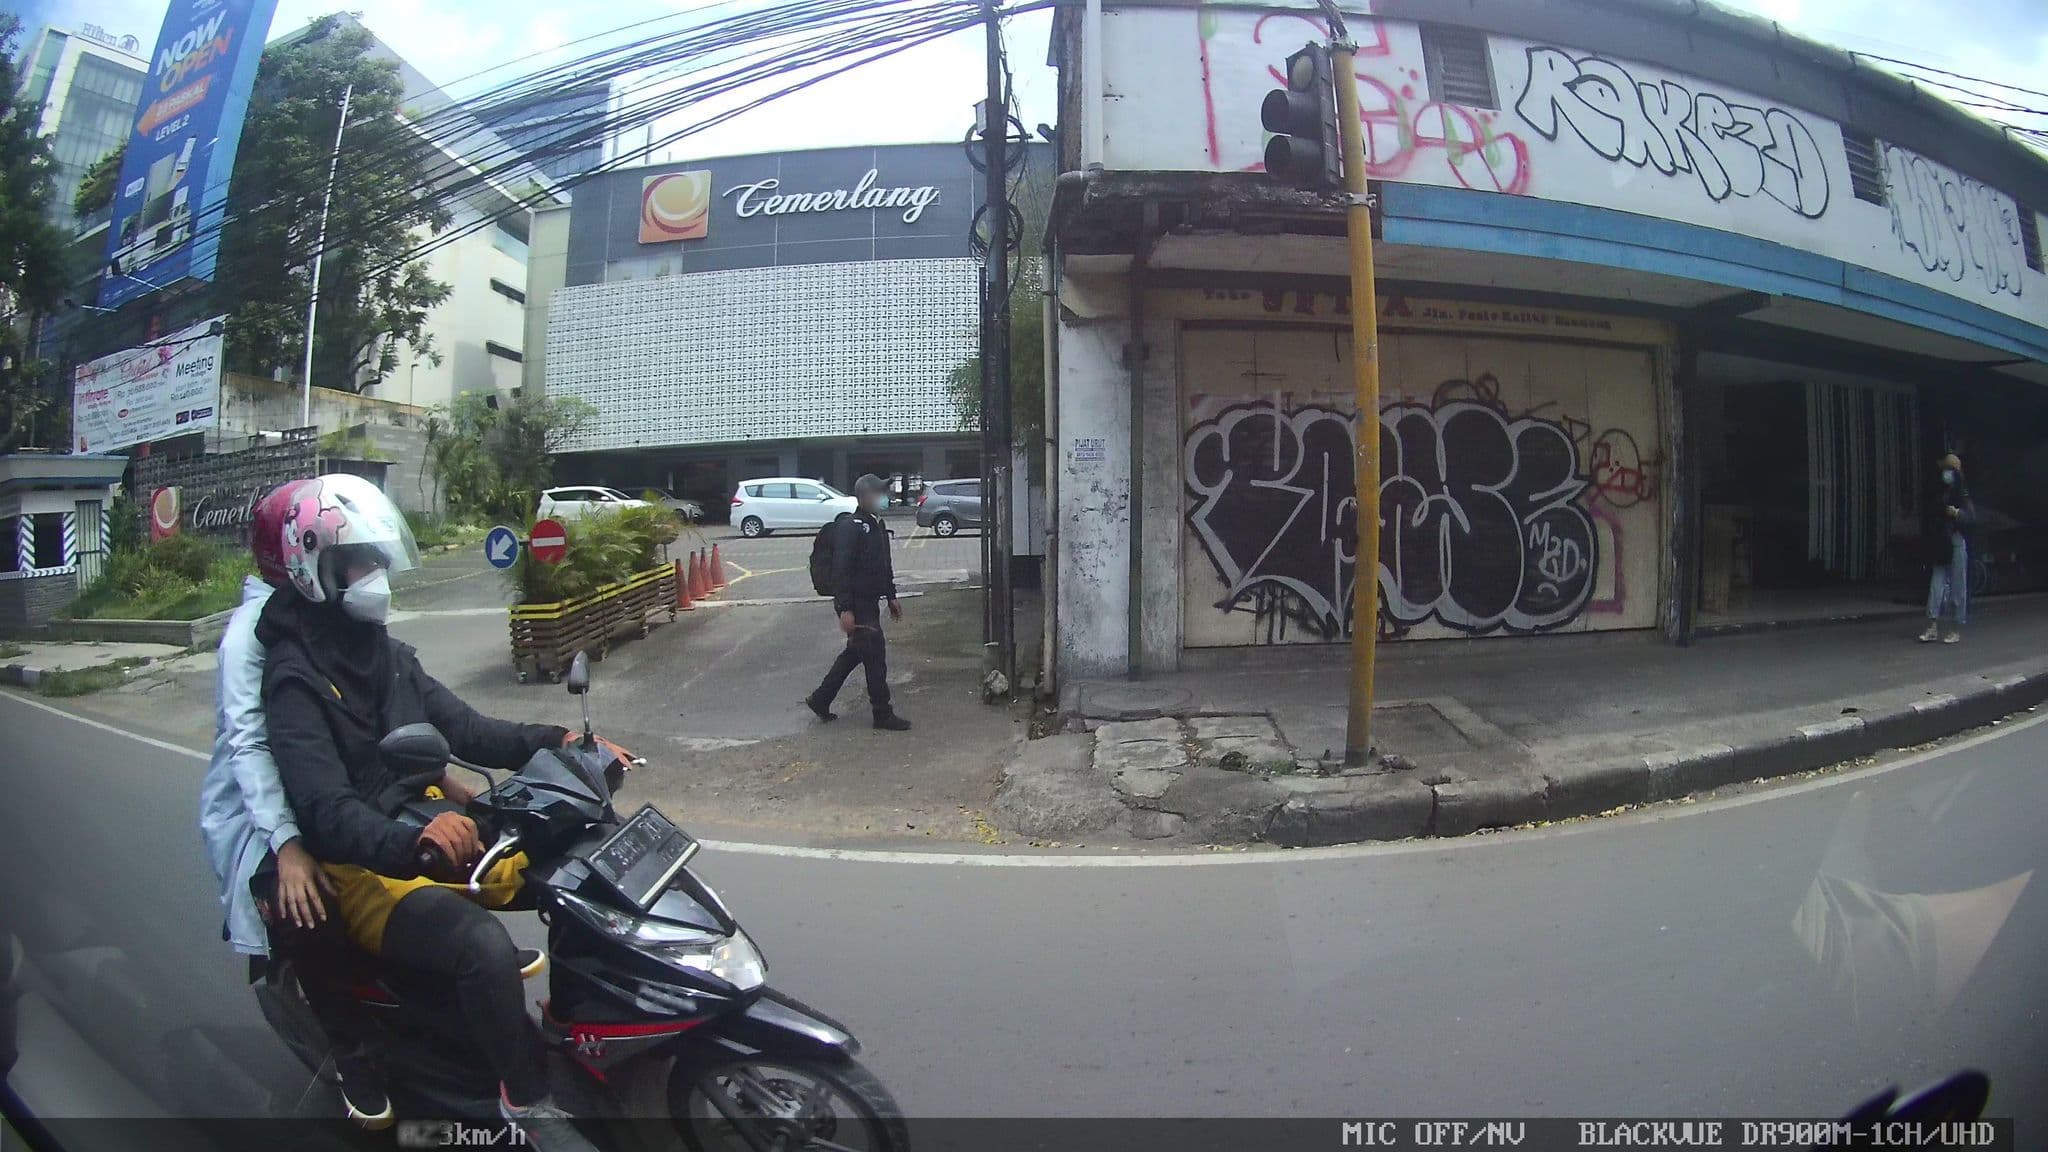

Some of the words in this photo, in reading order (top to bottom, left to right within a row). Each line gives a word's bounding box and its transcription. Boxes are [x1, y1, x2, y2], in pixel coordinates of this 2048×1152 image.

[155, 9, 228, 76] NOW
[160, 26, 235, 92] OPEN
[155, 118, 182, 142] LEVEL
[181, 113, 191, 128] 2
[722, 168, 940, 224] Cemerlang
[175, 355, 214, 378] Meeting
[193, 486, 261, 529] Cemerl
